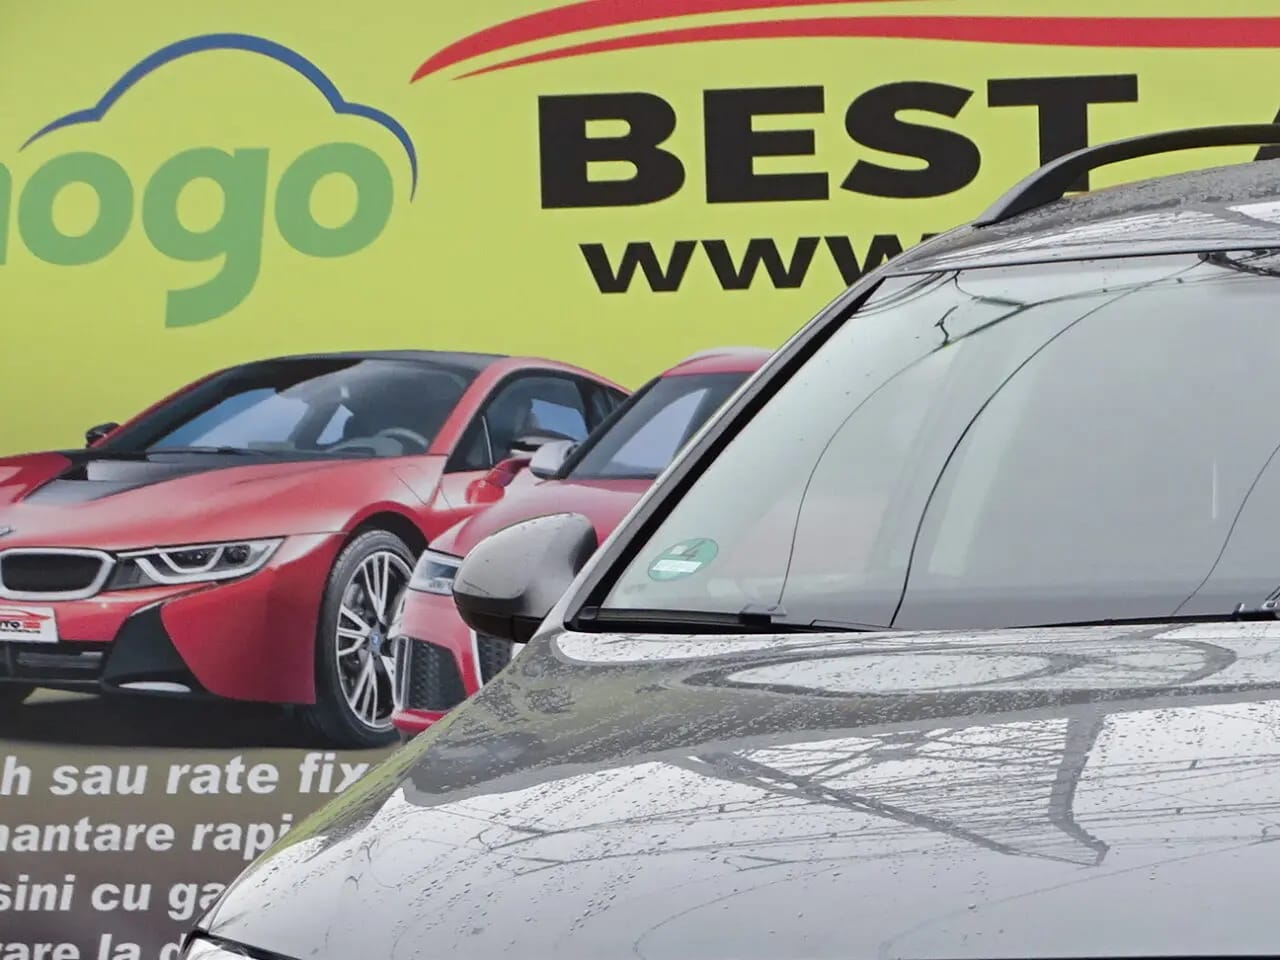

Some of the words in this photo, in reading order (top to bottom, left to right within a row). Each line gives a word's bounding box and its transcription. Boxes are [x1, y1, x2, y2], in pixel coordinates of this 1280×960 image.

[537, 74, 1138, 209] BEST
[0, 141, 394, 328] ogo
[50, 764, 148, 795] sau
[166, 756, 279, 794] rate
[0, 816, 175, 851] antare
[92, 883, 151, 911] cu
